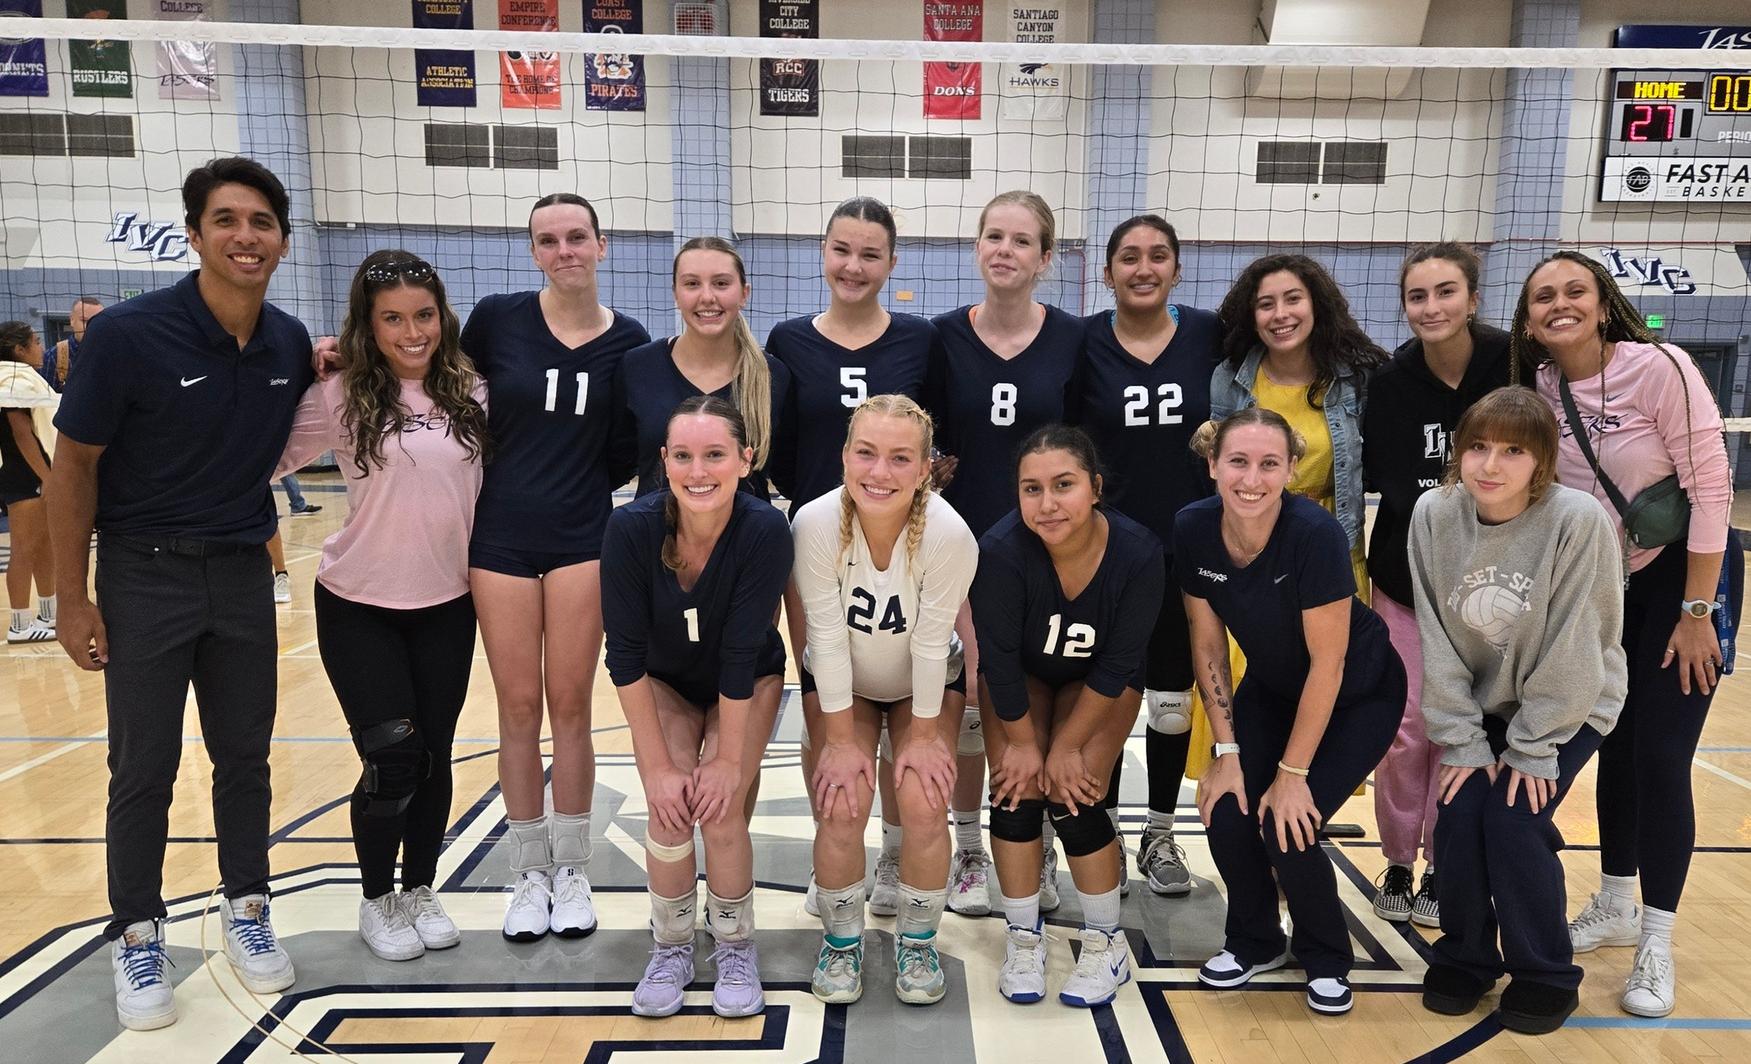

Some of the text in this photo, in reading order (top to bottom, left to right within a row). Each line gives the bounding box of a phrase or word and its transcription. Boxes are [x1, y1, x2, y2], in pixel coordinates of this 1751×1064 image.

[160, 1, 203, 13] COLLEGE
[426, 4, 461, 14] COLLEGE
[510, 2, 545, 13] EMPIRE
[780, 6, 799, 16] CITY
[926, 4, 981, 16] SANTA ANA
[592, 8, 632, 20] COLLEGE
[1013, 9, 1058, 19] SANTIAGO
[501, 15, 556, 26] CONFERENCE
[769, 18, 810, 29] COLLEGE
[934, 19, 973, 30] COLLEGE
[1017, 22, 1054, 32] CANYON
[1016, 34, 1055, 43] COLLEGE
[426, 65, 467, 76] ATHLETIC
[775, 63, 802, 74] RCC
[72, 69, 129, 84] RUSTLERS
[1009, 76, 1059, 87] HAWKS
[420, 77, 474, 89] ASSOCIATION
[591, 83, 637, 98] PIRATES
[768, 88, 809, 102] TIGERS
[933, 86, 975, 96] DONS
[1634, 81, 1687, 99] HOME
[1629, 105, 1675, 141] 27
[1628, 174, 1649, 185] FAB
[1665, 164, 1729, 184] FAST
[1682, 186, 1746, 197] BASKE
[106, 211, 189, 261] IVC
[1601, 249, 1697, 295] IVC
[544, 368, 589, 416] 11
[840, 367, 868, 408] 5
[990, 382, 1018, 427] 8
[1123, 382, 1184, 427] 22
[847, 586, 907, 636] 24
[683, 607, 700, 642] 1
[1042, 613, 1096, 658] 12
